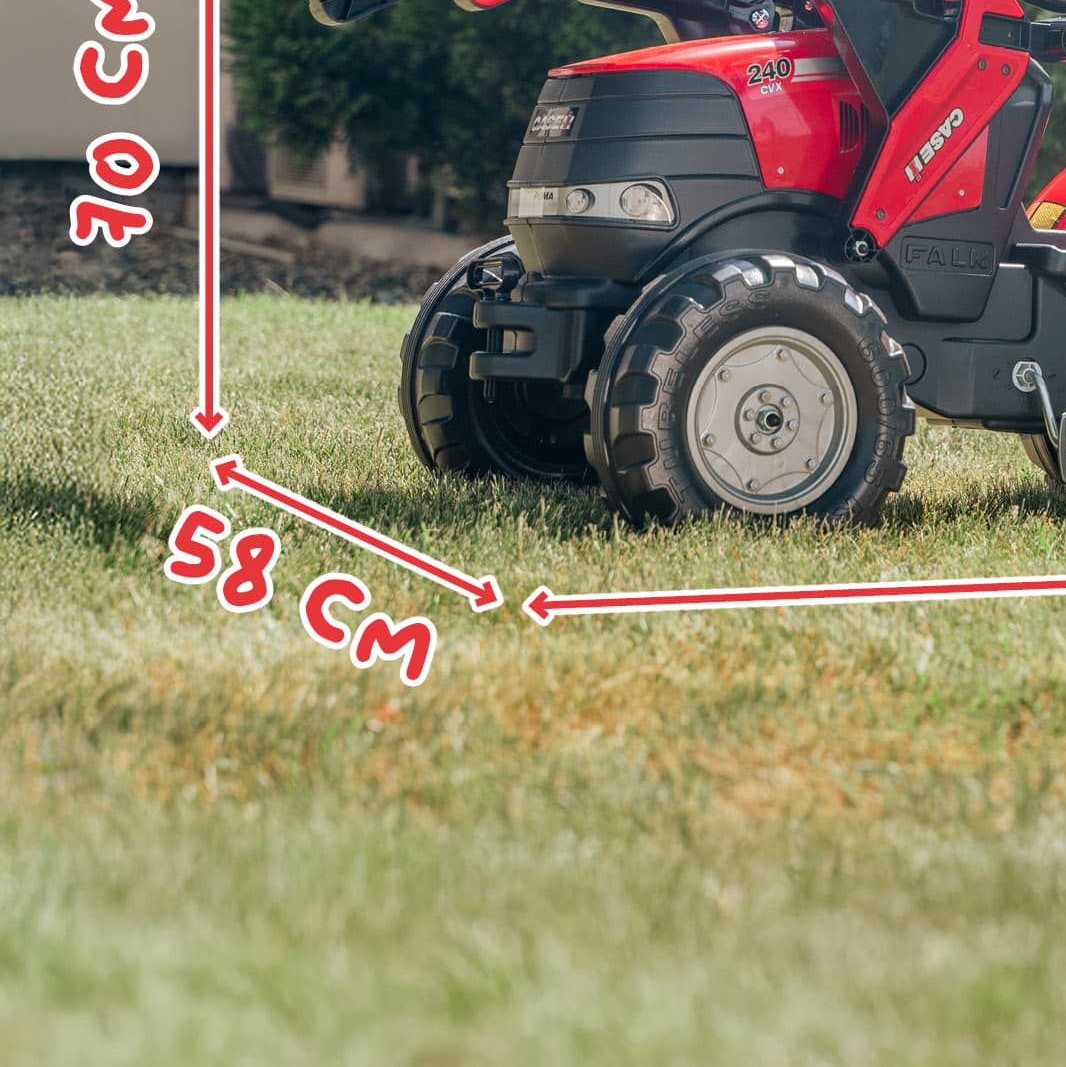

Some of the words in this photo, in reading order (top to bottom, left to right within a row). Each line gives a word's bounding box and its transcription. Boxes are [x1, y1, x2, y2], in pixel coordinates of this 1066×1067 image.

[746, 56, 792, 86] 240
[760, 82, 783, 95] CVX
[918, 107, 965, 165] CASE
[905, 243, 989, 269] FALK
[657, 288, 770, 504] TUBELESS
